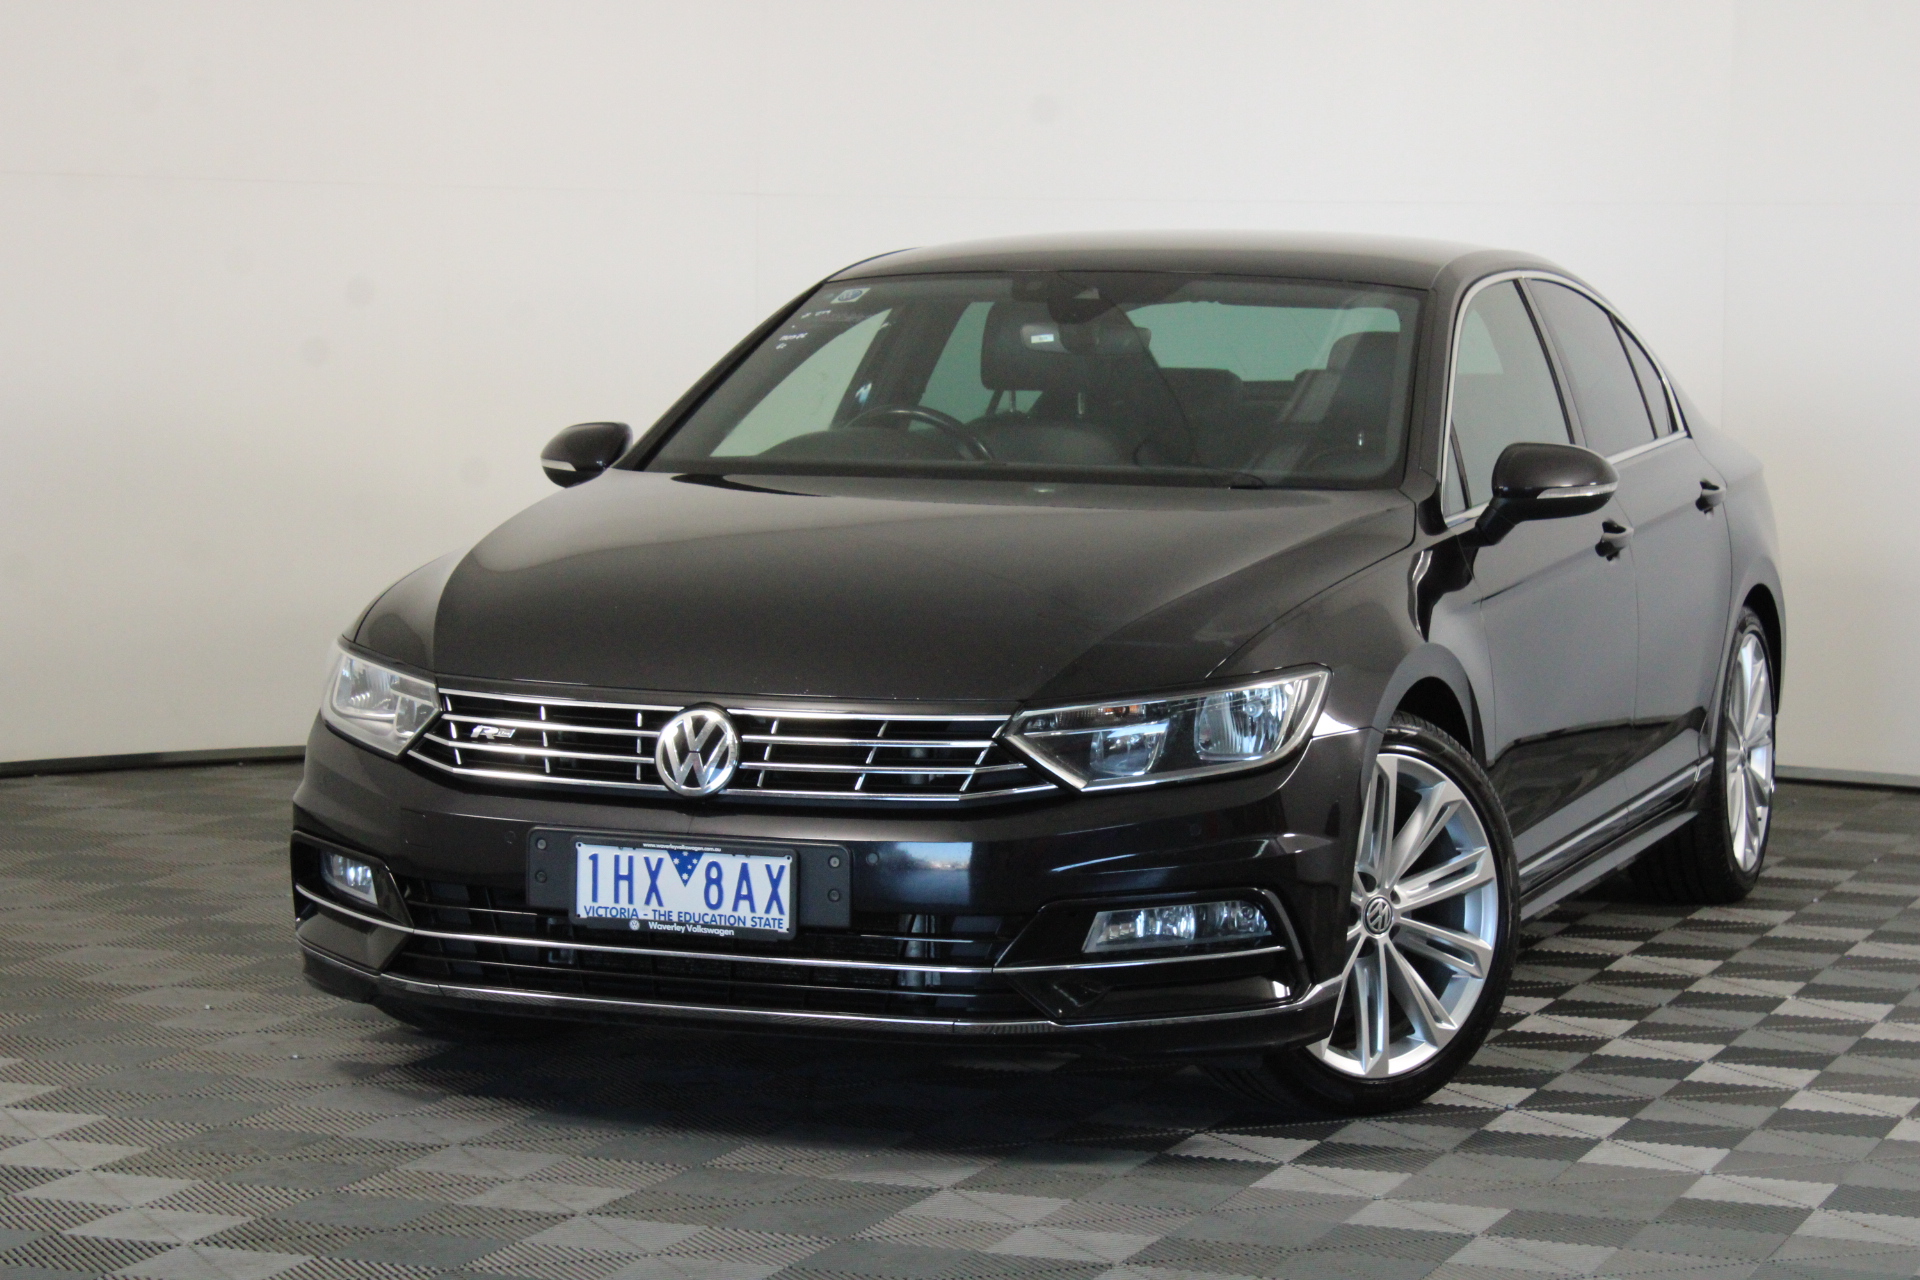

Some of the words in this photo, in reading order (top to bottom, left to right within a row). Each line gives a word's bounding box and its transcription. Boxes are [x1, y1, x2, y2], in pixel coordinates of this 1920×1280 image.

[588, 853, 664, 907] 1HX
[704, 860, 786, 915] 8AX
[583, 906, 639, 919] VICTORIA
[652, 909, 673, 921] THE
[677, 911, 746, 927] EDUCATION
[751, 916, 784, 929] STATE
[649, 921, 685, 933] Waverley
[686, 924, 735, 936] Volkswagen
